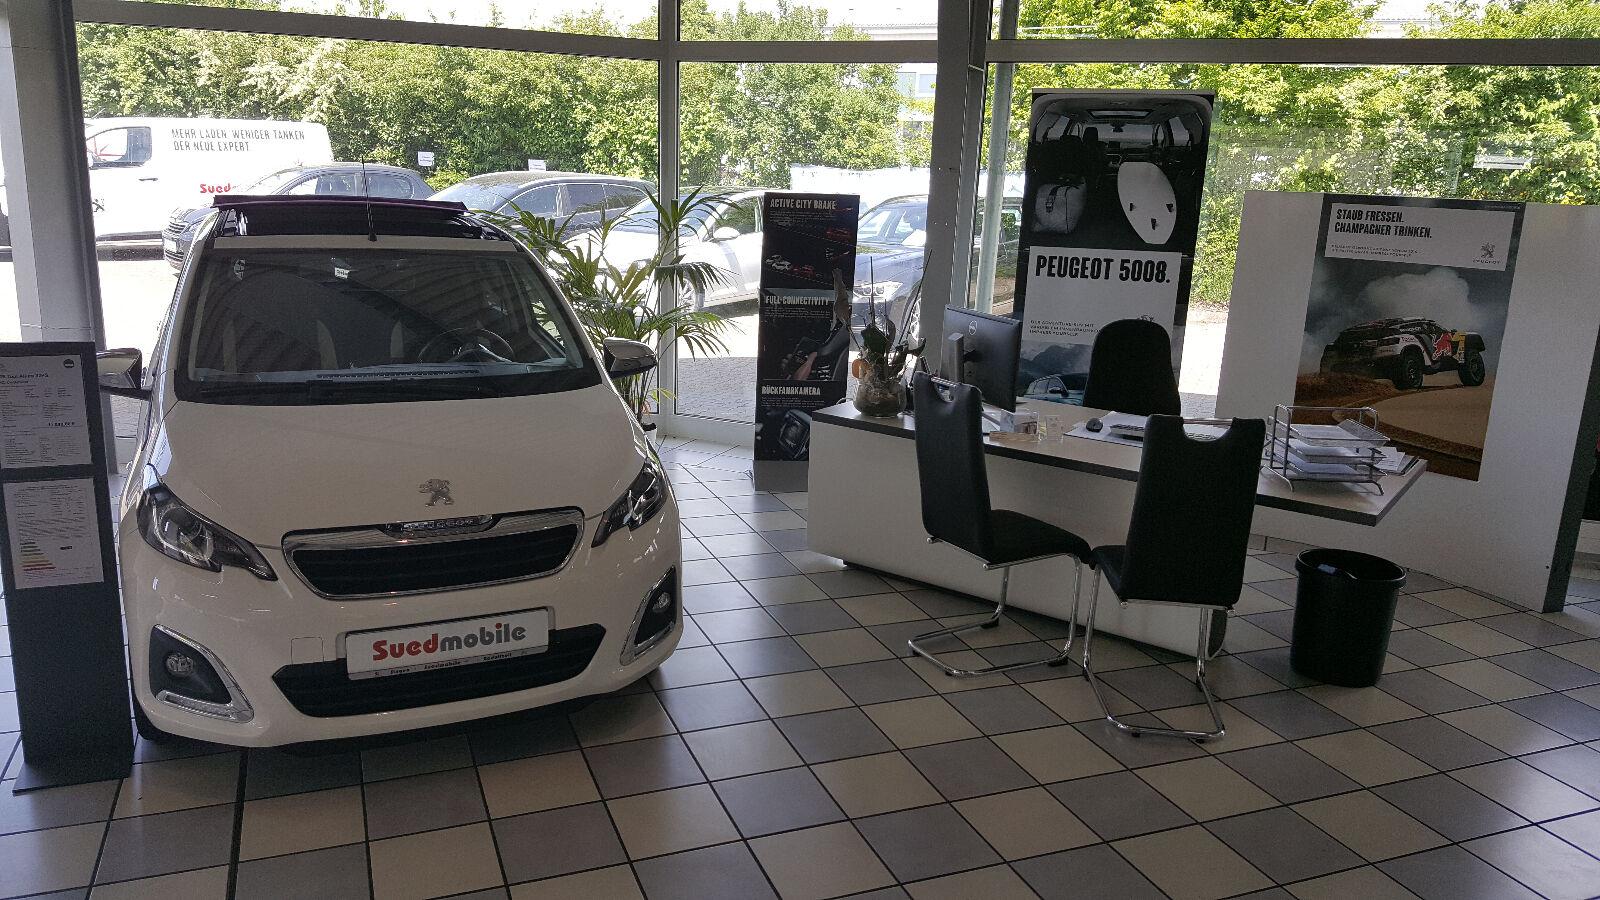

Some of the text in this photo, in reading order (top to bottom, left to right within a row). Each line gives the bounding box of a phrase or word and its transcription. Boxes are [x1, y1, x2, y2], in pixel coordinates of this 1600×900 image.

[171, 128, 197, 139] MEHR
[232, 129, 270, 140] WENIGER
[273, 129, 305, 141] TANKEN
[173, 140, 250, 153] DER NEUE EXPERT
[769, 198, 837, 210] ACTIVE CITY BRAKE
[1336, 208, 1405, 223] STAUB FRESSEN.
[1334, 221, 1433, 239] CHAMPAGNER TRINKEN.
[1035, 254, 1171, 284] PEUGEOT 5008.
[761, 384, 821, 396] RÜCKFAHRKAMERA
[372, 622, 527, 662] Suedmobile
